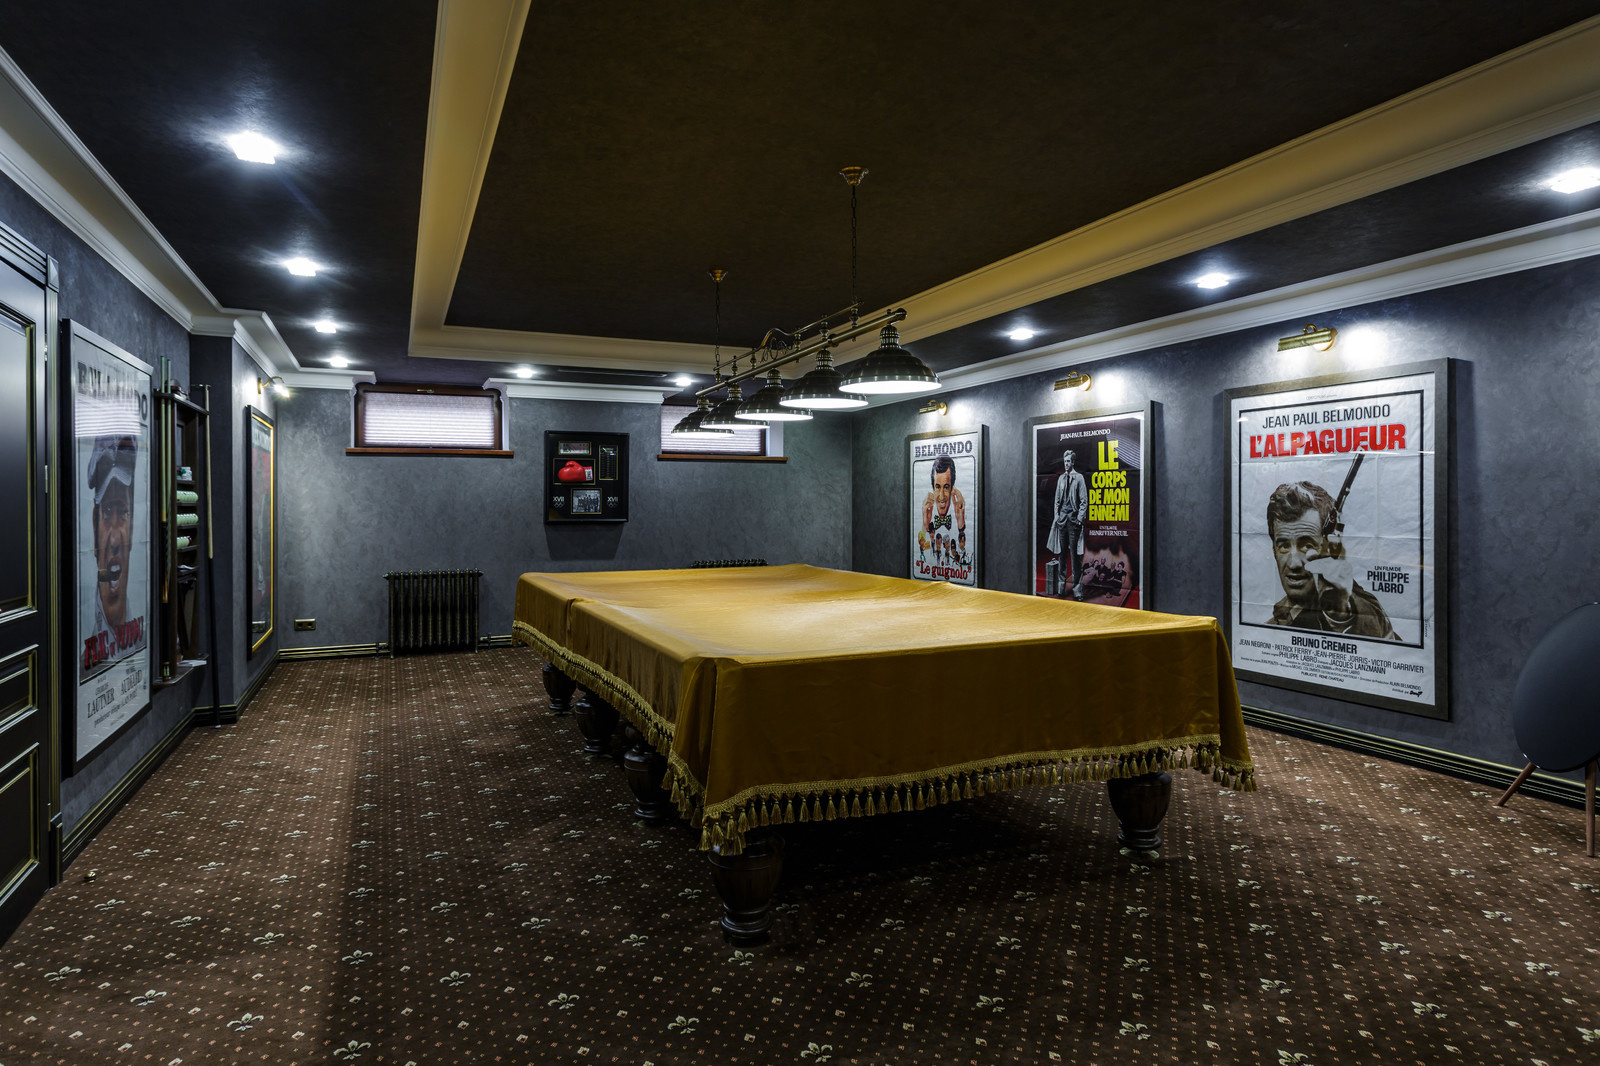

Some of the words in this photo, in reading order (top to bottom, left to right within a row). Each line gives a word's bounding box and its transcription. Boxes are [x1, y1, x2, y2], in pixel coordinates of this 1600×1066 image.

[1262, 415, 1289, 429] JEAN
[1293, 412, 1320, 426] PAUL
[1323, 404, 1390, 423] BELMONDO
[1083, 428, 1111, 437] BELMONDO
[1250, 424, 1406, 458] L'ALPAGUEUR
[915, 440, 973, 458] BELMONDO
[1098, 440, 1119, 470] LE
[1091, 470, 1127, 488] CORPS
[1089, 489, 1101, 505] DE
[1103, 488, 1130, 505] MON
[1089, 504, 1130, 521] ENNEMI
[1367, 570, 1409, 584] PHILIPPE
[1372, 581, 1404, 594] LABRO
[1291, 636, 1320, 649] BRUNO
[1321, 639, 1357, 655] CREMER
[1239, 639, 1250, 647] JEAN
[1250, 640, 1272, 650] NEGRONI
[1275, 643, 1293, 653] PATRICK
[1314, 650, 1347, 662] JEAN-PIERRE
[1371, 659, 1392, 668] VICTOR
[1392, 662, 1424, 674] GARRIVIER
[1279, 651, 1299, 660] PHILIPPE
[1300, 655, 1318, 663] LABRO
[1329, 659, 1355, 669] JACQUES
[1354, 662, 1386, 675] LANZMANN
[87, 687, 115, 718] LAUTNER
